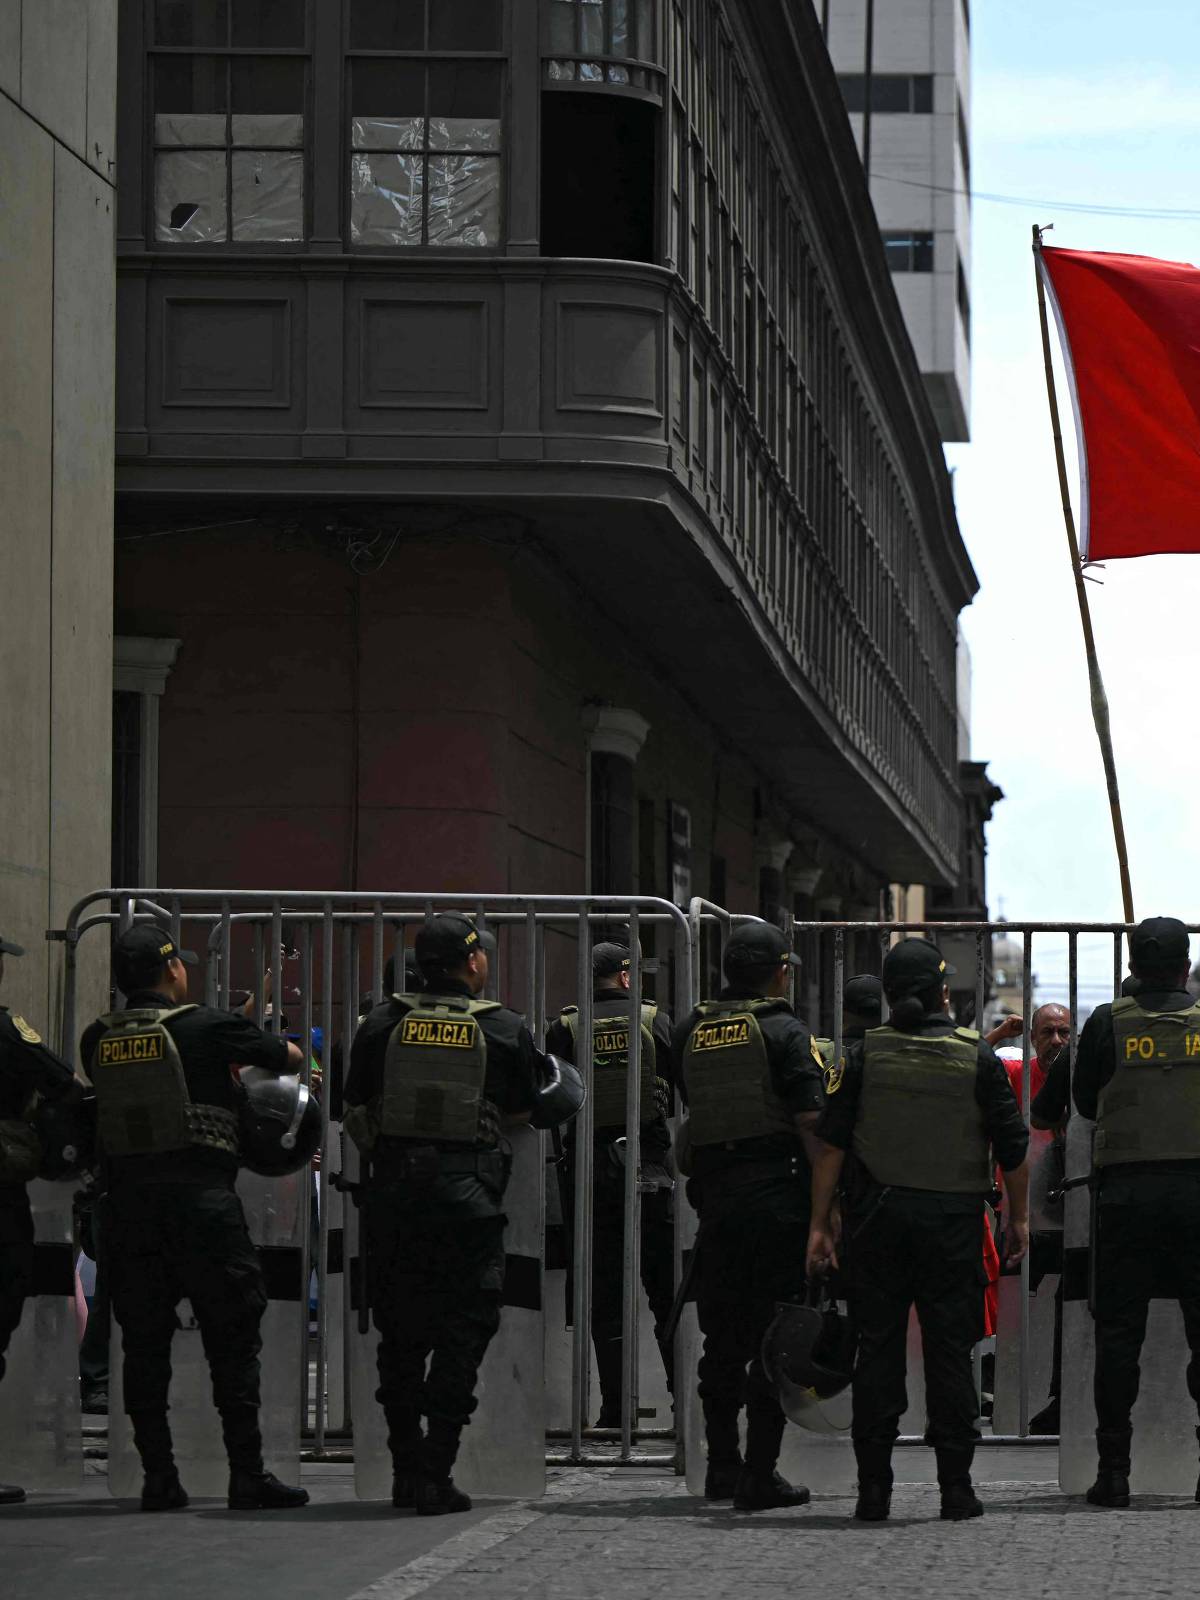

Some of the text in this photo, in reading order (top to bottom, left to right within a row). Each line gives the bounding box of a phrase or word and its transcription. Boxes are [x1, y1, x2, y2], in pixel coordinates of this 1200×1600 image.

[405, 1021, 470, 1045] POLICIA
[695, 1023, 748, 1048] POLICIA
[101, 1037, 158, 1063] POLICIA
